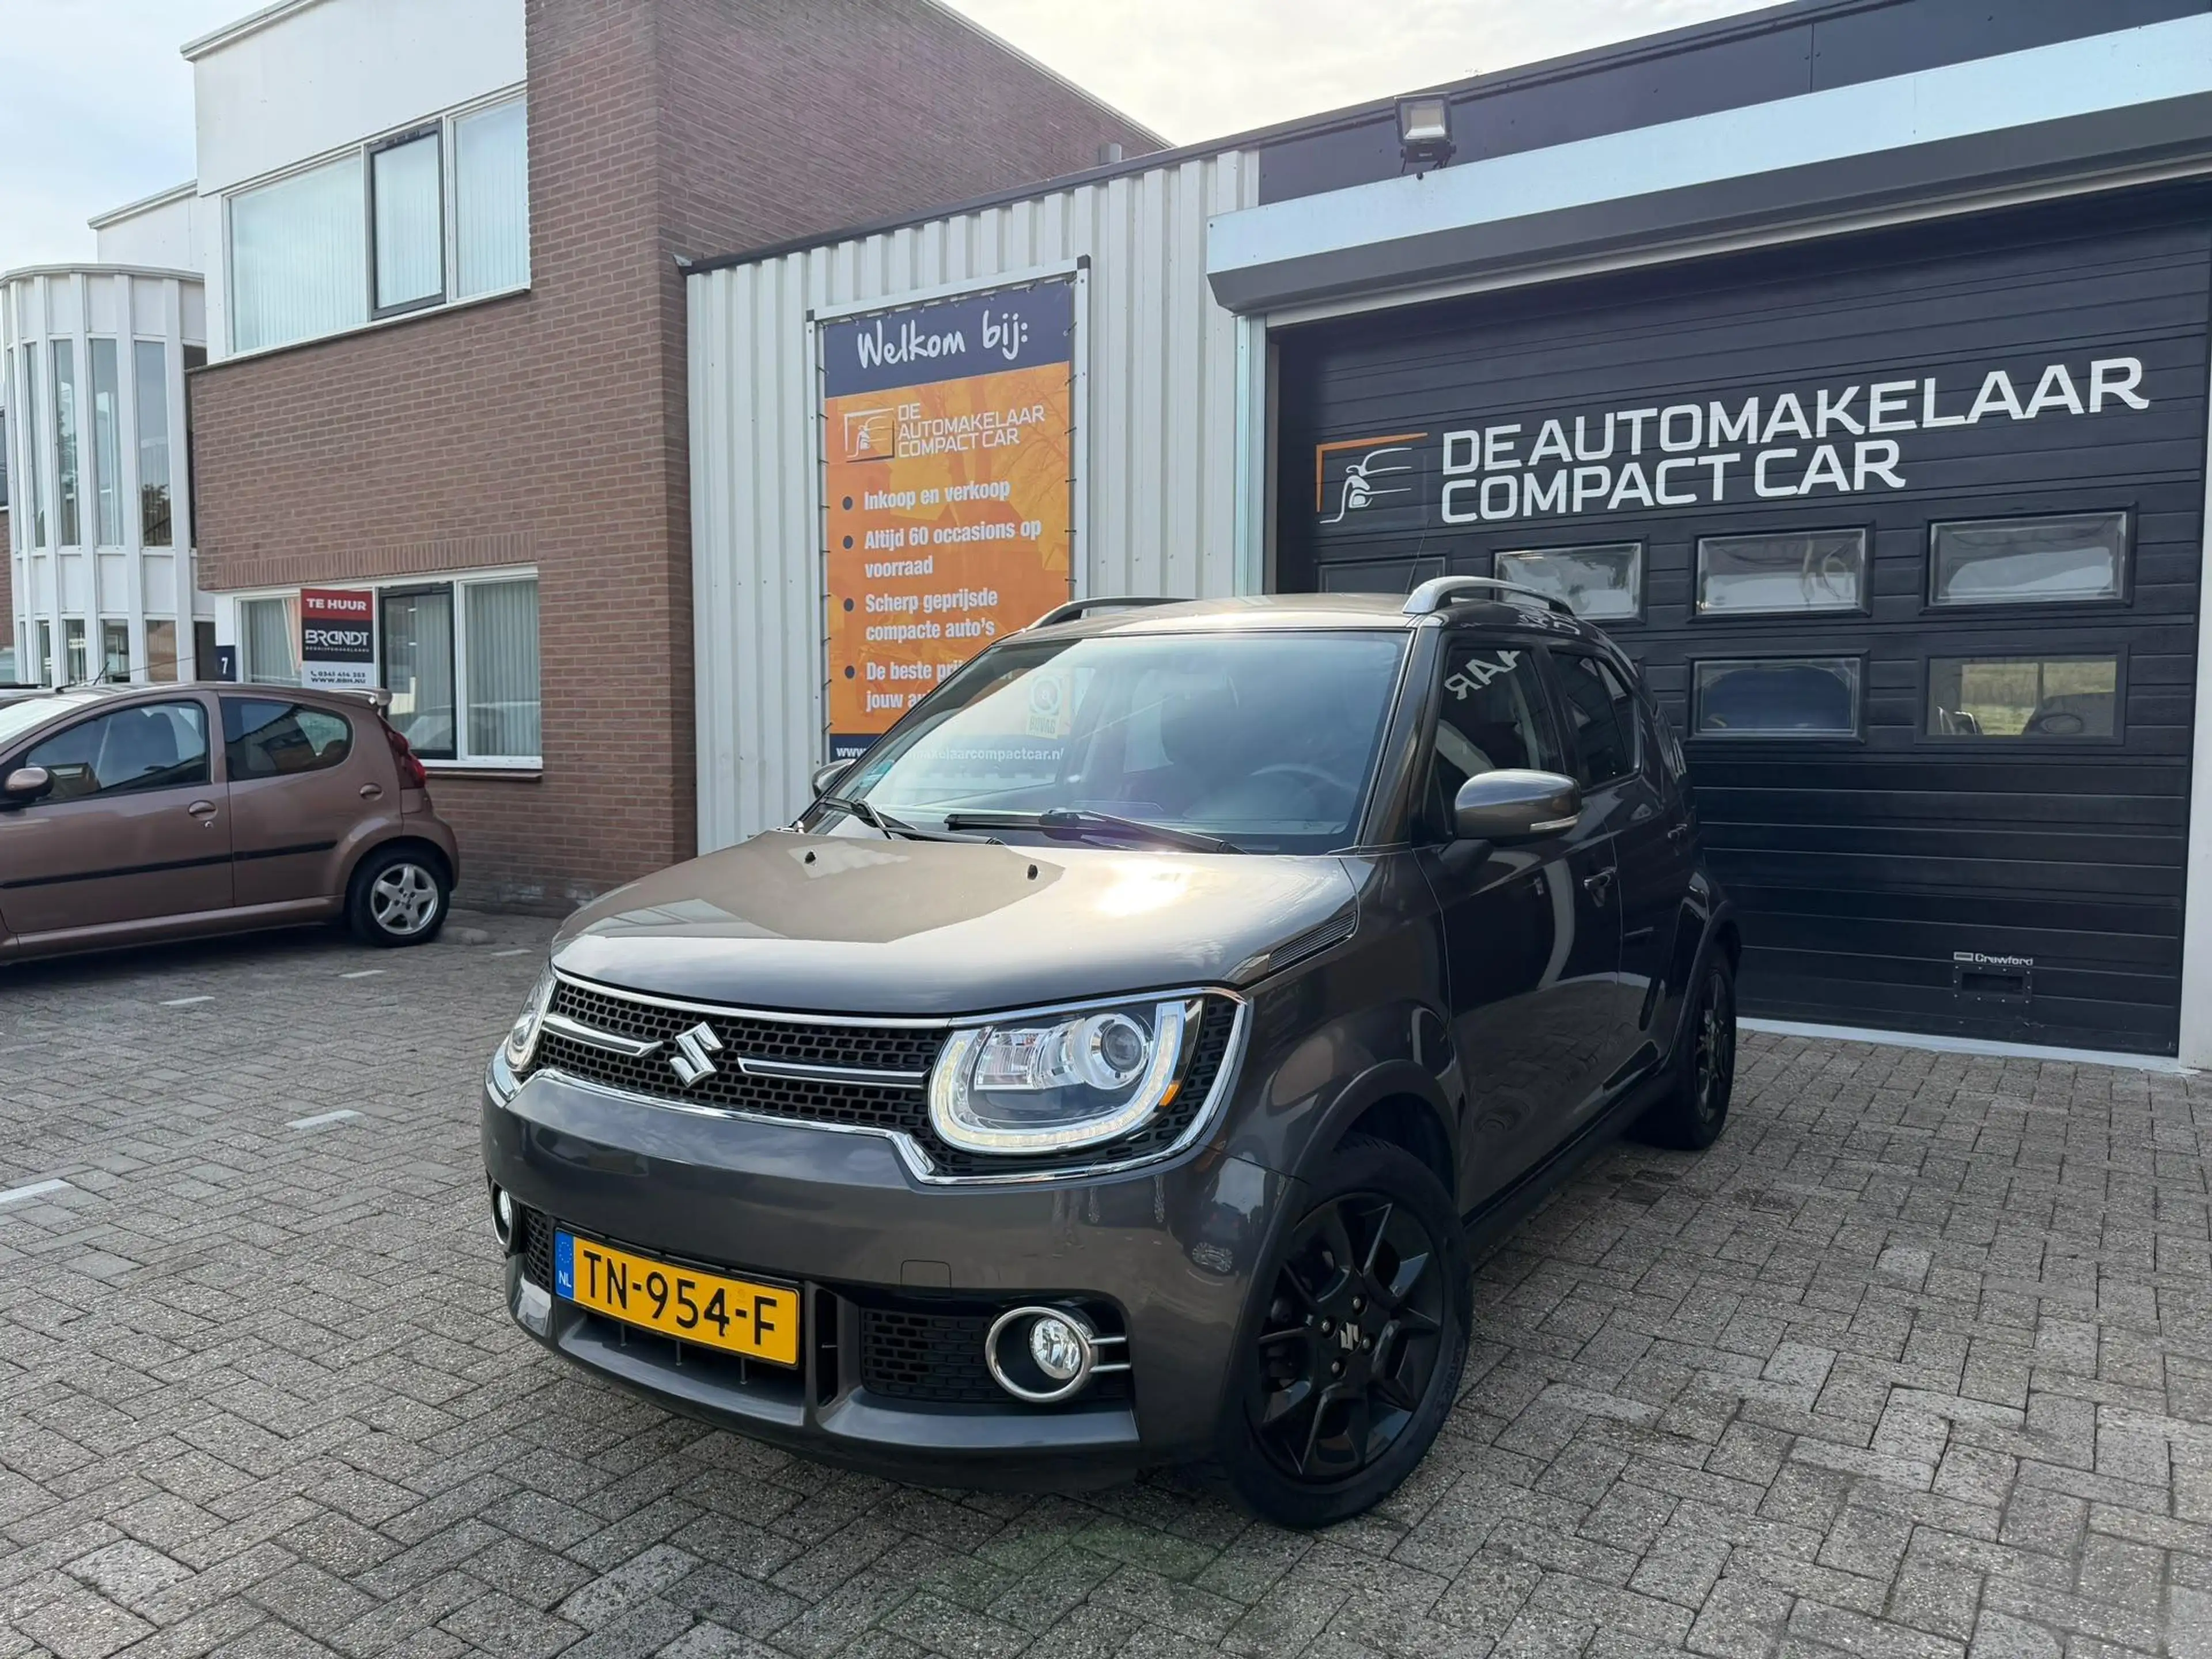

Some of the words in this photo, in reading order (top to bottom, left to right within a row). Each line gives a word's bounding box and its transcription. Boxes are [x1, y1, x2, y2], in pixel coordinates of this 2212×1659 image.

[858, 319, 965, 369] Welkom
[983, 310, 1028, 360] bij:
[898, 403, 921, 421] DE
[898, 405, 1044, 441] AUTOMAKELAAR
[1442, 423, 1522, 476] DE
[1528, 356, 2150, 466] AUTOMAKELAAR
[899, 434, 978, 458] COMPACT
[982, 428, 1020, 448] CAR
[1441, 452, 1740, 524] COMPACT
[1754, 439, 1906, 498] CAR
[864, 491, 915, 510] Inkoop
[921, 486, 940, 504] en
[945, 480, 1010, 502] verkoop
[865, 528, 904, 551] Altijd
[909, 527, 928, 545] 60
[934, 521, 1015, 544] occasions
[1021, 520, 1041, 538] op
[865, 555, 933, 578] voorraad
[306, 598, 325, 608] TE
[327, 599, 366, 611] HUUR
[866, 593, 918, 614] Scherp
[923, 588, 998, 614] geprijsde
[866, 622, 940, 643] compacte
[945, 619, 995, 637] auto's
[221, 657, 229, 675] 7
[867, 661, 885, 680] De
[891, 660, 931, 679] beste
[866, 691, 903, 712] jouw
[1975, 953, 2033, 966] Crawford
[559, 1270, 572, 1289] NL
[583, 1249, 777, 1346] TN-954-F
